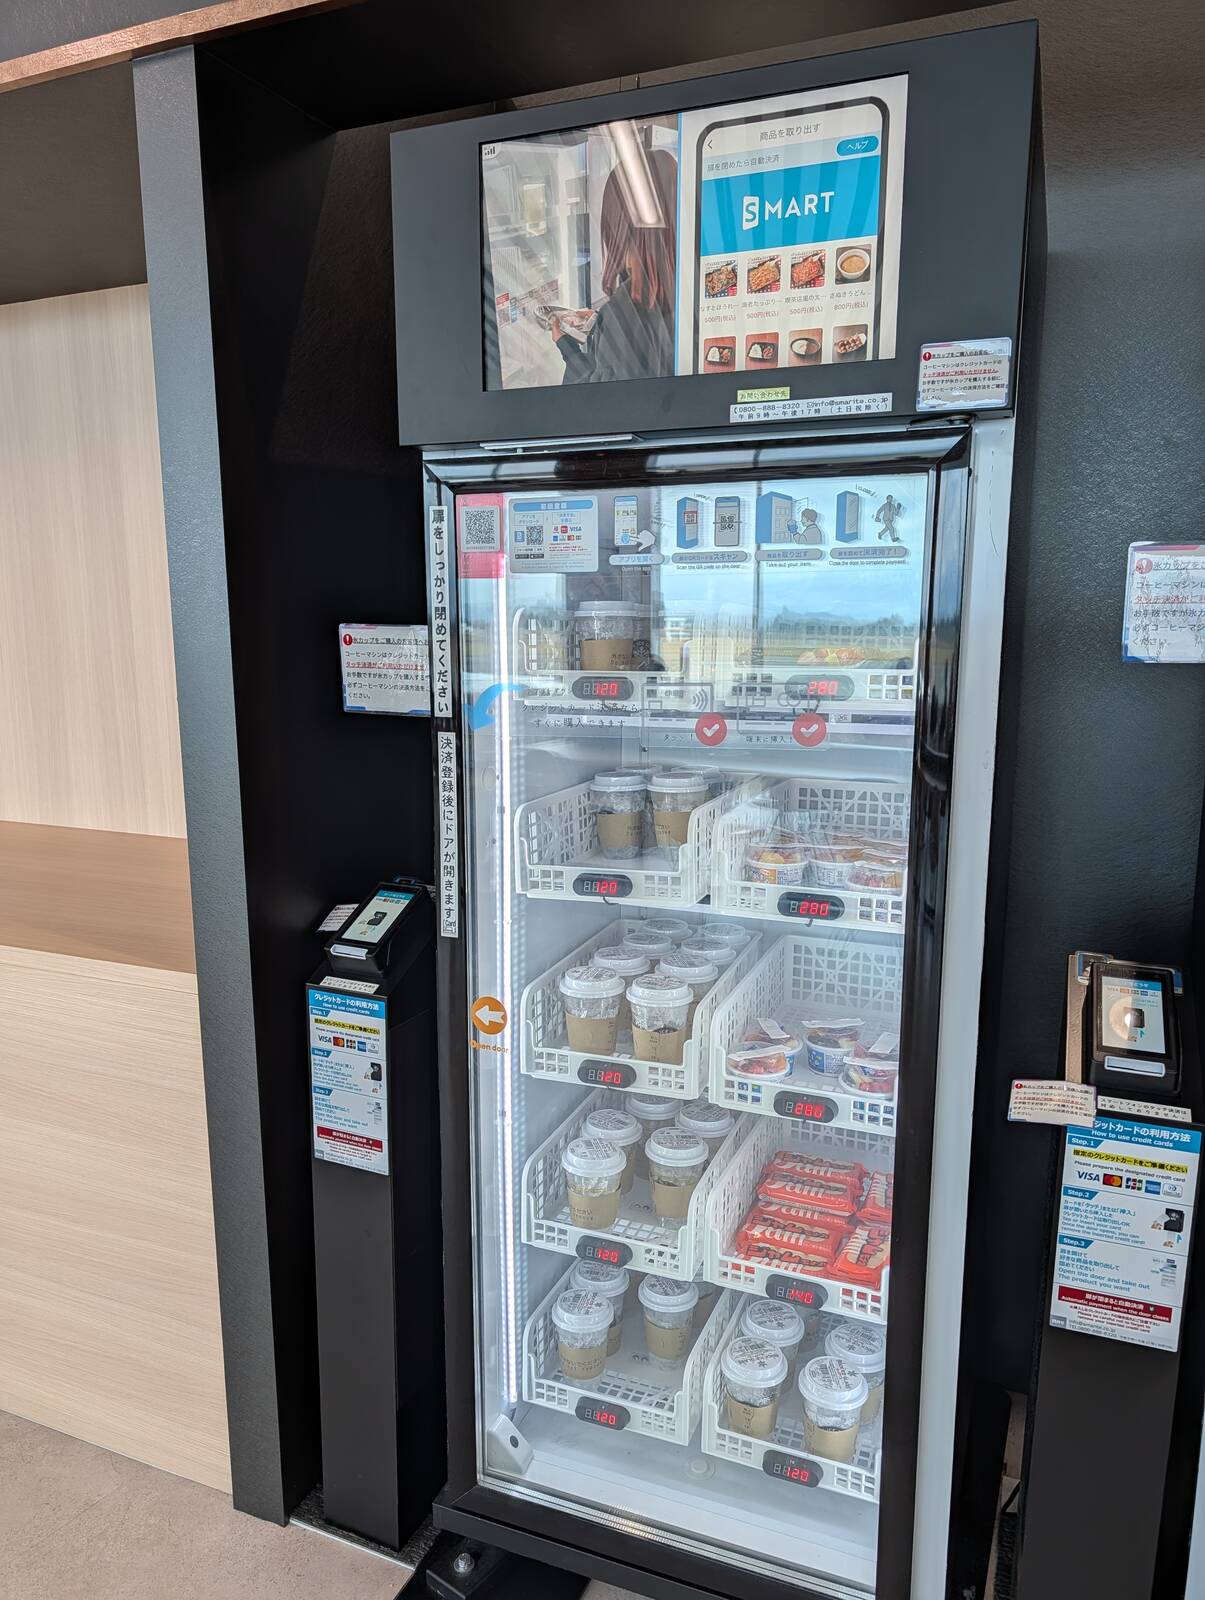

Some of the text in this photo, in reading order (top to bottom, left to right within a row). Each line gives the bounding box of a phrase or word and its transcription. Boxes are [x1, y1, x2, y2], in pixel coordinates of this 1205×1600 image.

[760, 124, 821, 141] 商品を取り出す
[846, 141, 868, 152] ヘルプ
[708, 155, 780, 171] 扉を閉めたら自動決済
[743, 192, 835, 227] SMART
[739, 389, 787, 400] お問い合わせ先
[431, 508, 449, 713] 扉をしっかり閉めてください
[808, 681, 838, 695] 280
[533, 717, 625, 729] すぐに購入できます
[440, 735, 456, 918] 決済登録後にドアが開きます
[799, 901, 828, 916] 280
[314, 993, 380, 1011] クレジットカードの利用方法
[318, 1035, 332, 1043] VISA
[492, 1044, 508, 1055] door
[795, 1103, 823, 1118] 280
[1100, 1098, 1187, 1115] スマートフォンのタッチ決済は
[1092, 1129, 1107, 1138] How
[1131, 1135, 1152, 1144] credit
[1153, 1139, 1174, 1147] cards
[1076, 1171, 1101, 1183] VISA
[1092, 1163, 1114, 1171] prepare
[1125, 1168, 1154, 1178] designated
[1156, 1173, 1172, 1181] credit
[1067, 1189, 1090, 1198] Step.2
[1063, 1238, 1085, 1247] Step.3
[1058, 1267, 1076, 1277] Open
[1089, 1272, 1106, 1281] door
[1121, 1278, 1137, 1287] take
[1138, 1282, 1150, 1290] out
[1071, 1276, 1098, 1287] product
[1099, 1281, 1112, 1290] you
[1113, 1284, 1131, 1292] want
[1061, 1296, 1088, 1306] Automatic
[1089, 1300, 1112, 1310] payment
